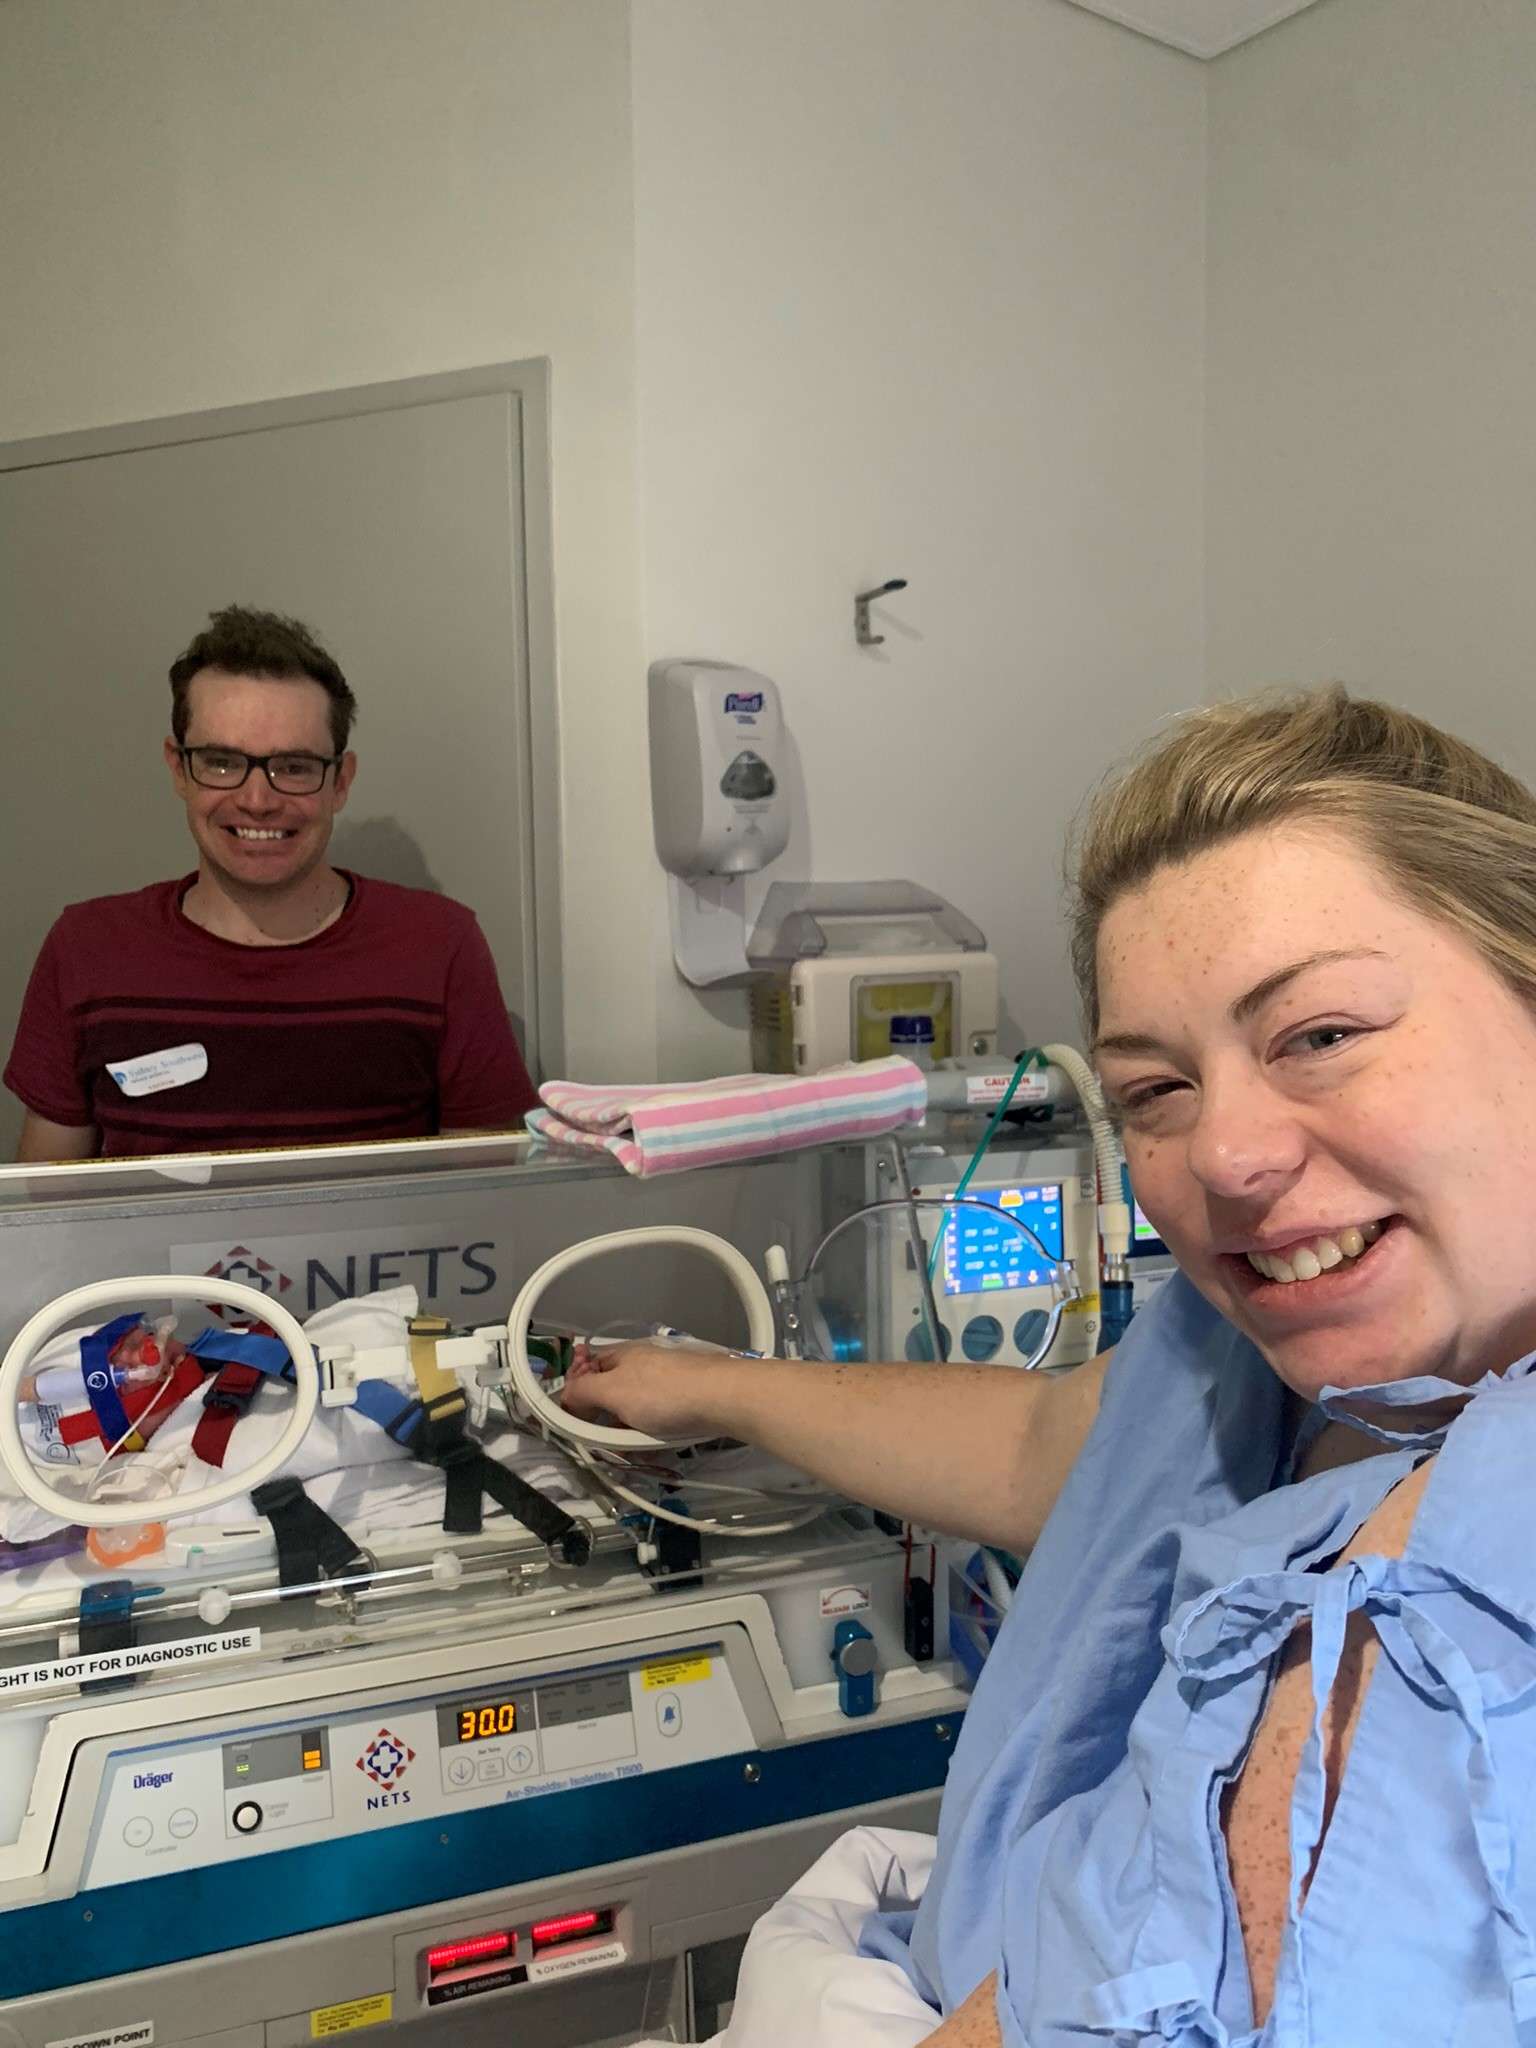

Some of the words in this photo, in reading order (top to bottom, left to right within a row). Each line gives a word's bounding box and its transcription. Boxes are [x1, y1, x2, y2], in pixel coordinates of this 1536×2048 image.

[984, 1077, 1031, 1086] CAUTN
[307, 1242, 497, 1310] NETS
[0, 1672, 29, 1688] GHT
[34, 1669, 49, 1682] IS
[53, 1663, 85, 1679] NOT
[89, 1657, 121, 1673] FOR
[126, 1641, 217, 1667] DIAGNOSTIC
[222, 1636, 251, 1650] USE
[461, 1704, 515, 1741] 30.0
[133, 1772, 173, 1790] Dräger
[367, 1790, 411, 1810] NETS
[544, 1960, 577, 1974] OXYGEN
[114, 2028, 150, 2044] POINT
